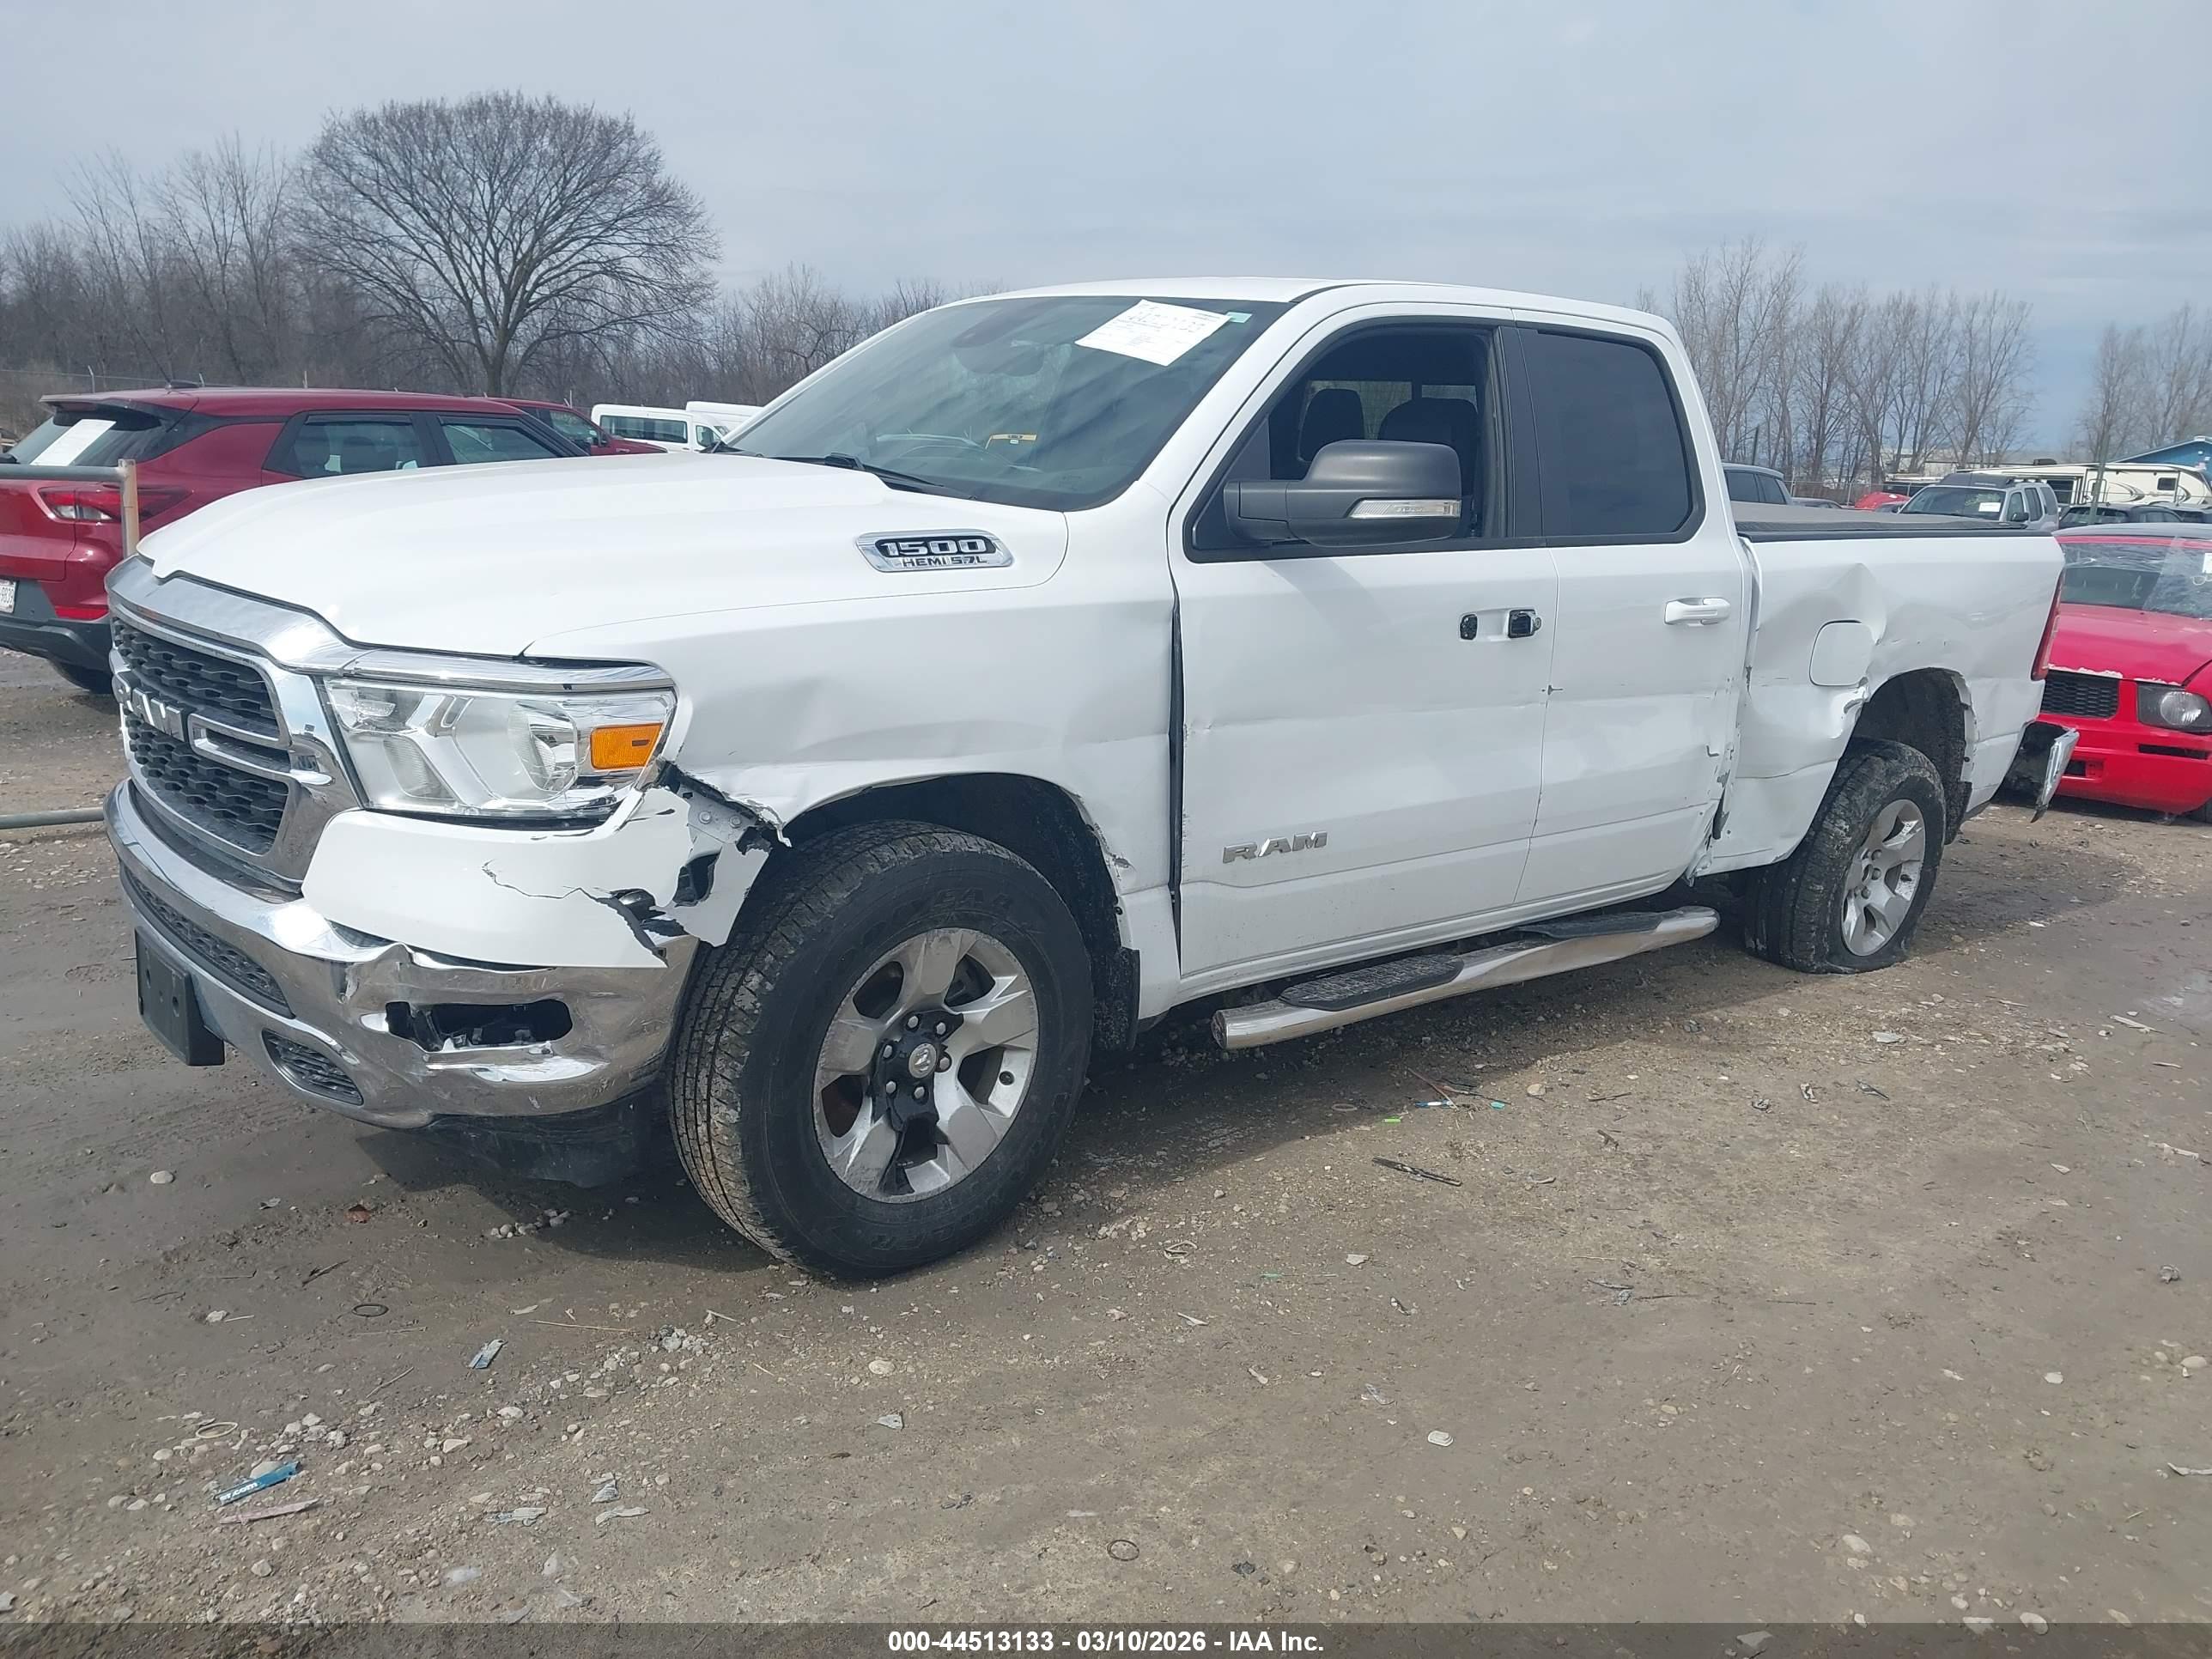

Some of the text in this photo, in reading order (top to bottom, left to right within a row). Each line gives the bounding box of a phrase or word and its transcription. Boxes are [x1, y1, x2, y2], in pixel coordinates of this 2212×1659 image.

[879, 538, 988, 557] 1500
[902, 556, 947, 568] HEMI
[112, 671, 185, 743] RAM
[1222, 830, 1328, 864] RAM
